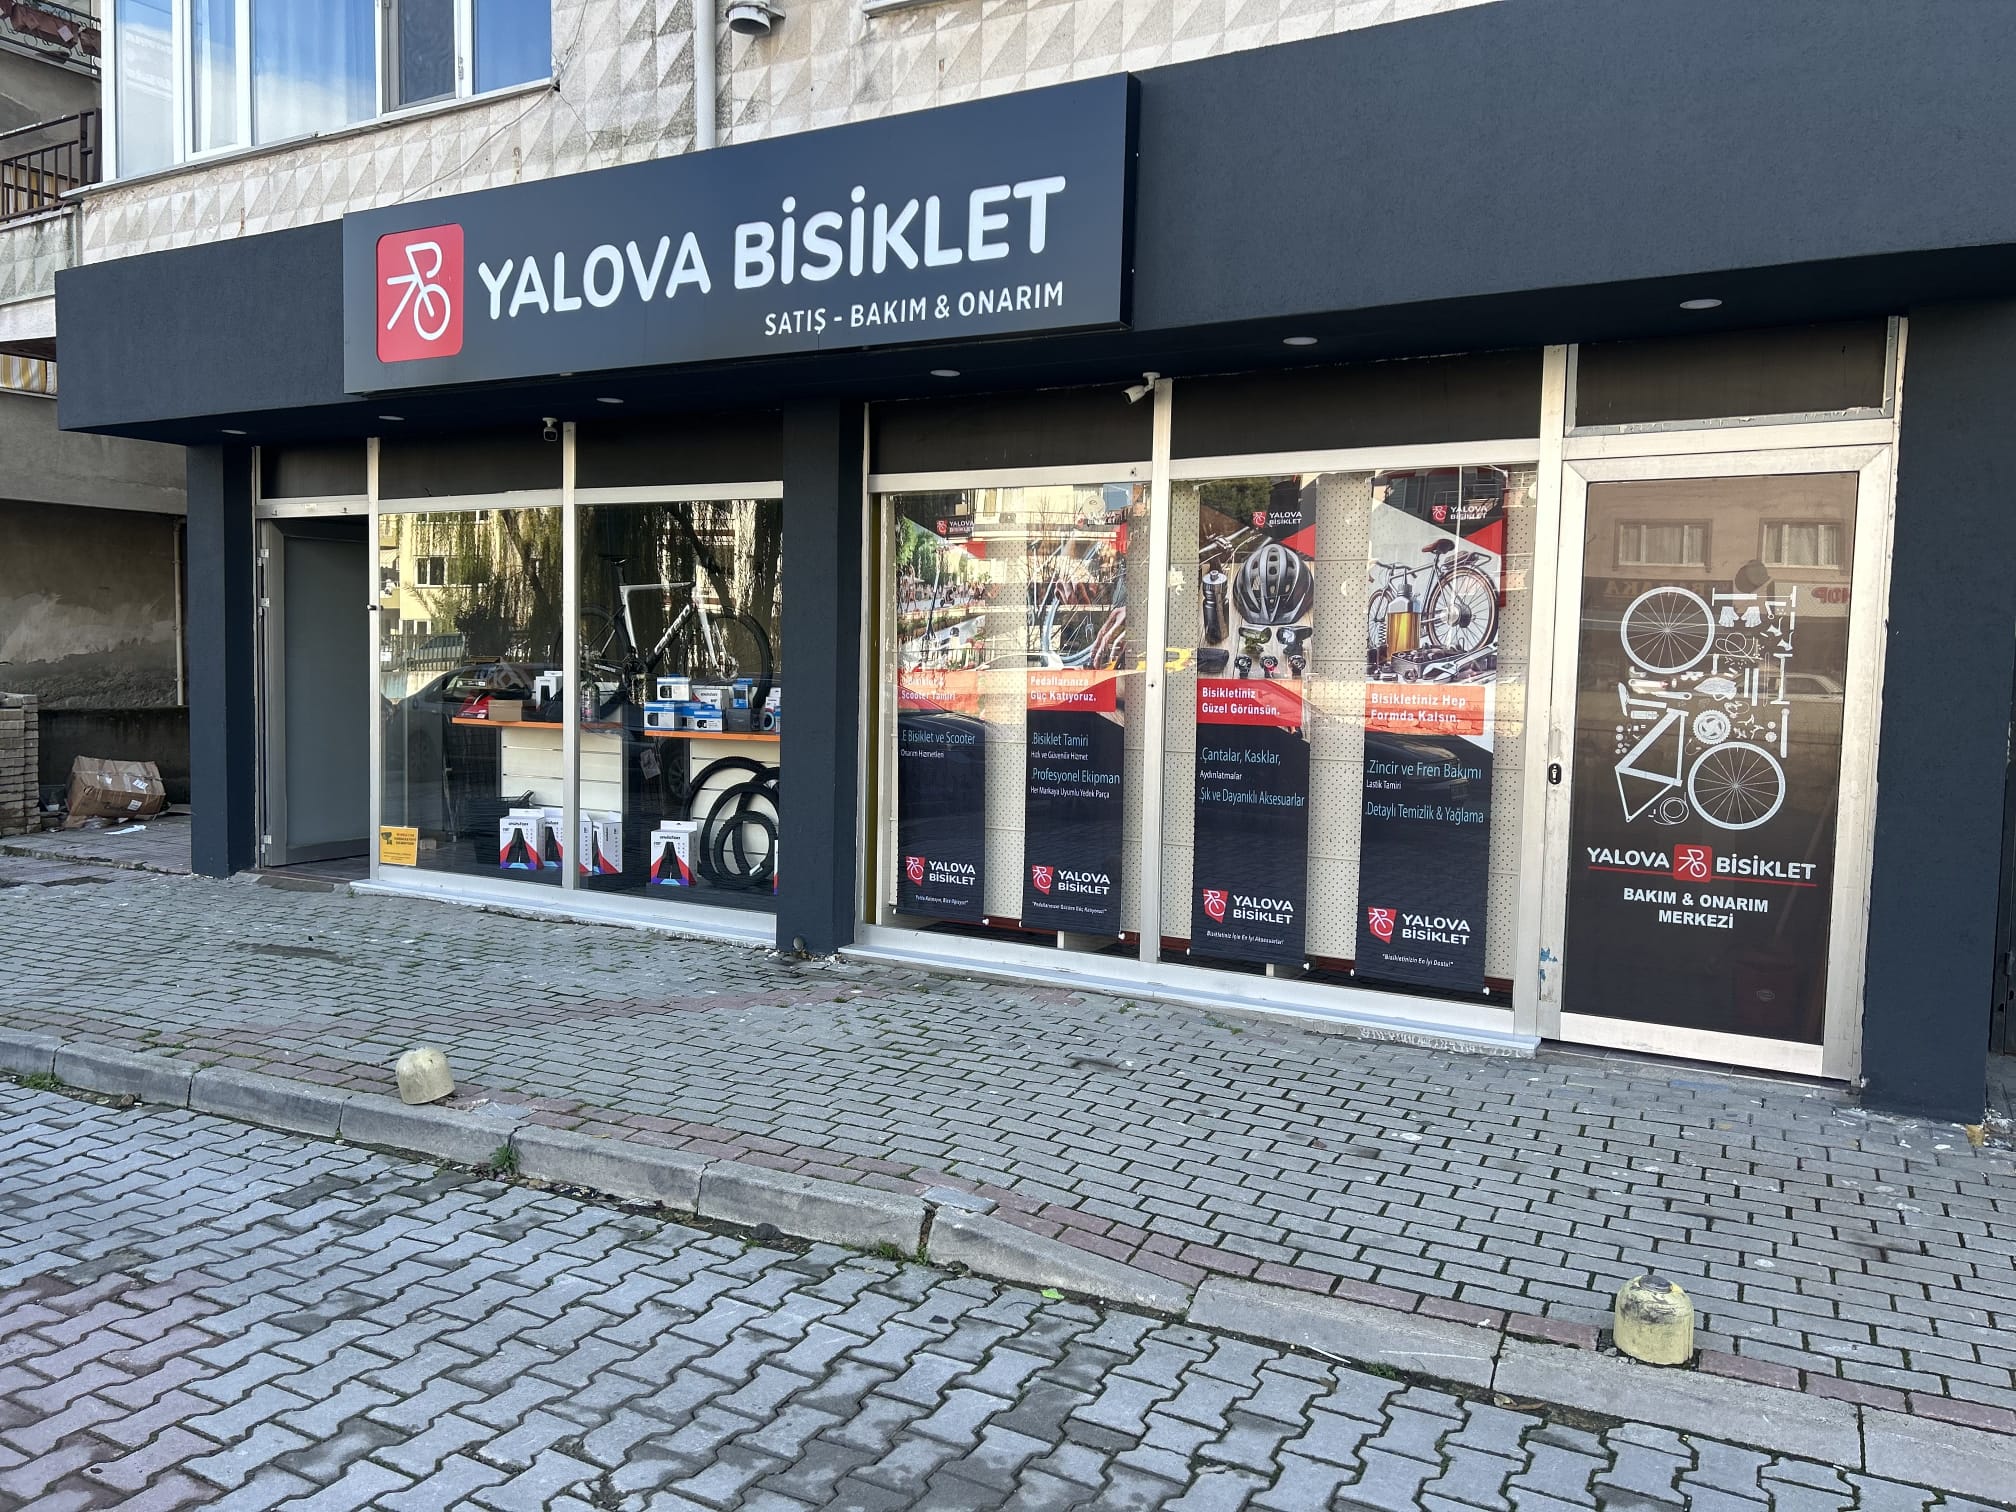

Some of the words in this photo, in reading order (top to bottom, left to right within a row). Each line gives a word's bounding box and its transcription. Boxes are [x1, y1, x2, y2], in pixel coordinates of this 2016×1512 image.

[477, 231, 712, 320] YALOVA
[733, 175, 1068, 292] BİSİKLET
[765, 308, 827, 336] SATIŞ
[850, 298, 928, 329] BAKIM
[934, 295, 951, 318] &
[958, 281, 1064, 317] ONARIM
[1269, 511, 1303, 519] YALOVA
[1450, 505, 1488, 513] YALOVA
[949, 519, 975, 527] YALOVA
[1030, 690, 1047, 702] Güç
[1202, 686, 1256, 700] Bisikletiniz
[1371, 692, 1438, 706] Bisikletiniz
[1442, 694, 1466, 709] Hep
[1202, 702, 1228, 715] Güzel
[1230, 703, 1281, 716] Görünsün.
[1371, 708, 1414, 722] Formda
[1418, 710, 1461, 723] Kalsın.
[908, 730, 935, 743] Bisiklet
[935, 734, 945, 744] ve
[946, 731, 976, 745] Scooter
[1063, 733, 1089, 747] Tamiri
[1244, 749, 1281, 766] Kasklar,
[1081, 770, 1120, 786] Ekipman
[1199, 769, 1242, 781] Aydınlatmalar
[1401, 764, 1414, 776] ve
[1417, 762, 1441, 778] Fren
[1443, 763, 1482, 780] Bakımı
[1366, 779, 1383, 789] Lastik
[1383, 780, 1402, 790] Tamiri
[1212, 792, 1221, 802] ve
[1222, 788, 1257, 804] Dayanıklı
[1259, 790, 1305, 807] Aksesuarlar
[1397, 802, 1434, 820] Temizlik
[1436, 806, 1444, 820] &
[1445, 806, 1484, 825] Yağlama
[929, 861, 976, 875] YALOVA
[1586, 846, 1670, 868] YALOVA
[1715, 853, 1818, 880] BİSİKLET
[929, 872, 976, 886] BİSİKLET
[1058, 869, 1111, 884] YALOVA
[1058, 882, 1111, 895] BİSİKLET
[1233, 895, 1294, 912] YALOVA
[1623, 887, 1677, 905] BAKIM
[1682, 893, 1694, 906] &
[1699, 894, 1769, 913] ONARIM
[1233, 907, 1294, 925] BİSİKLET
[1402, 912, 1471, 933] YALOVA
[1657, 909, 1735, 929] MERKEZİ
[1402, 927, 1470, 946] BİSİKLET
